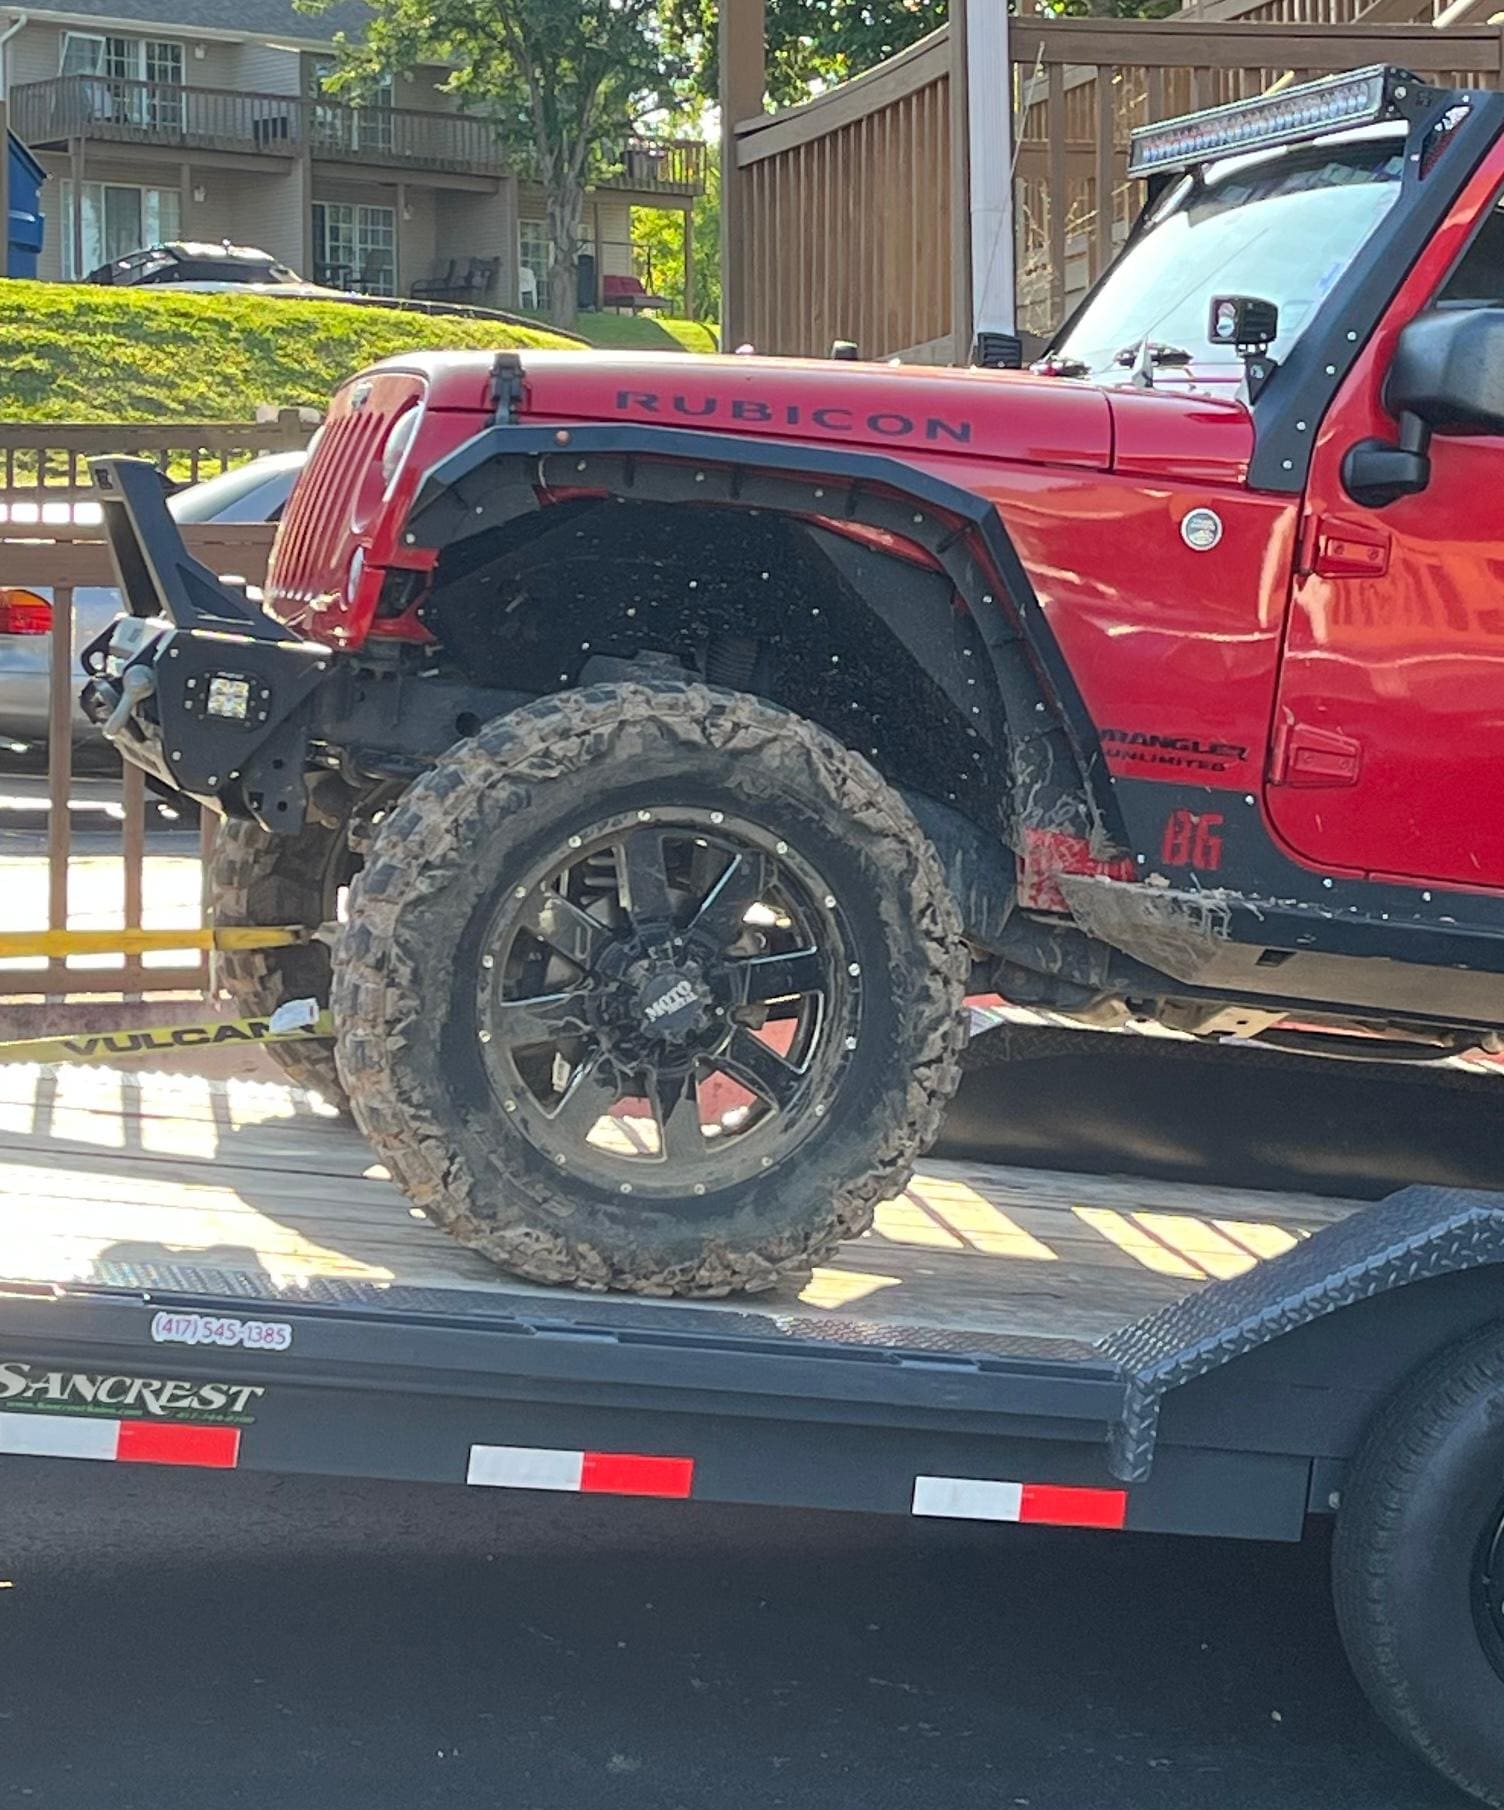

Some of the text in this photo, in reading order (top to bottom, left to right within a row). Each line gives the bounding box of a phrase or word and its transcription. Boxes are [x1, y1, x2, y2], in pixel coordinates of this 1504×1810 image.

[615, 390, 972, 444] RUBICON
[1106, 748, 1226, 772] UNLIMITED
[155, 1316, 199, 1340] (417)
[0, 1361, 265, 1416] SANCREST
